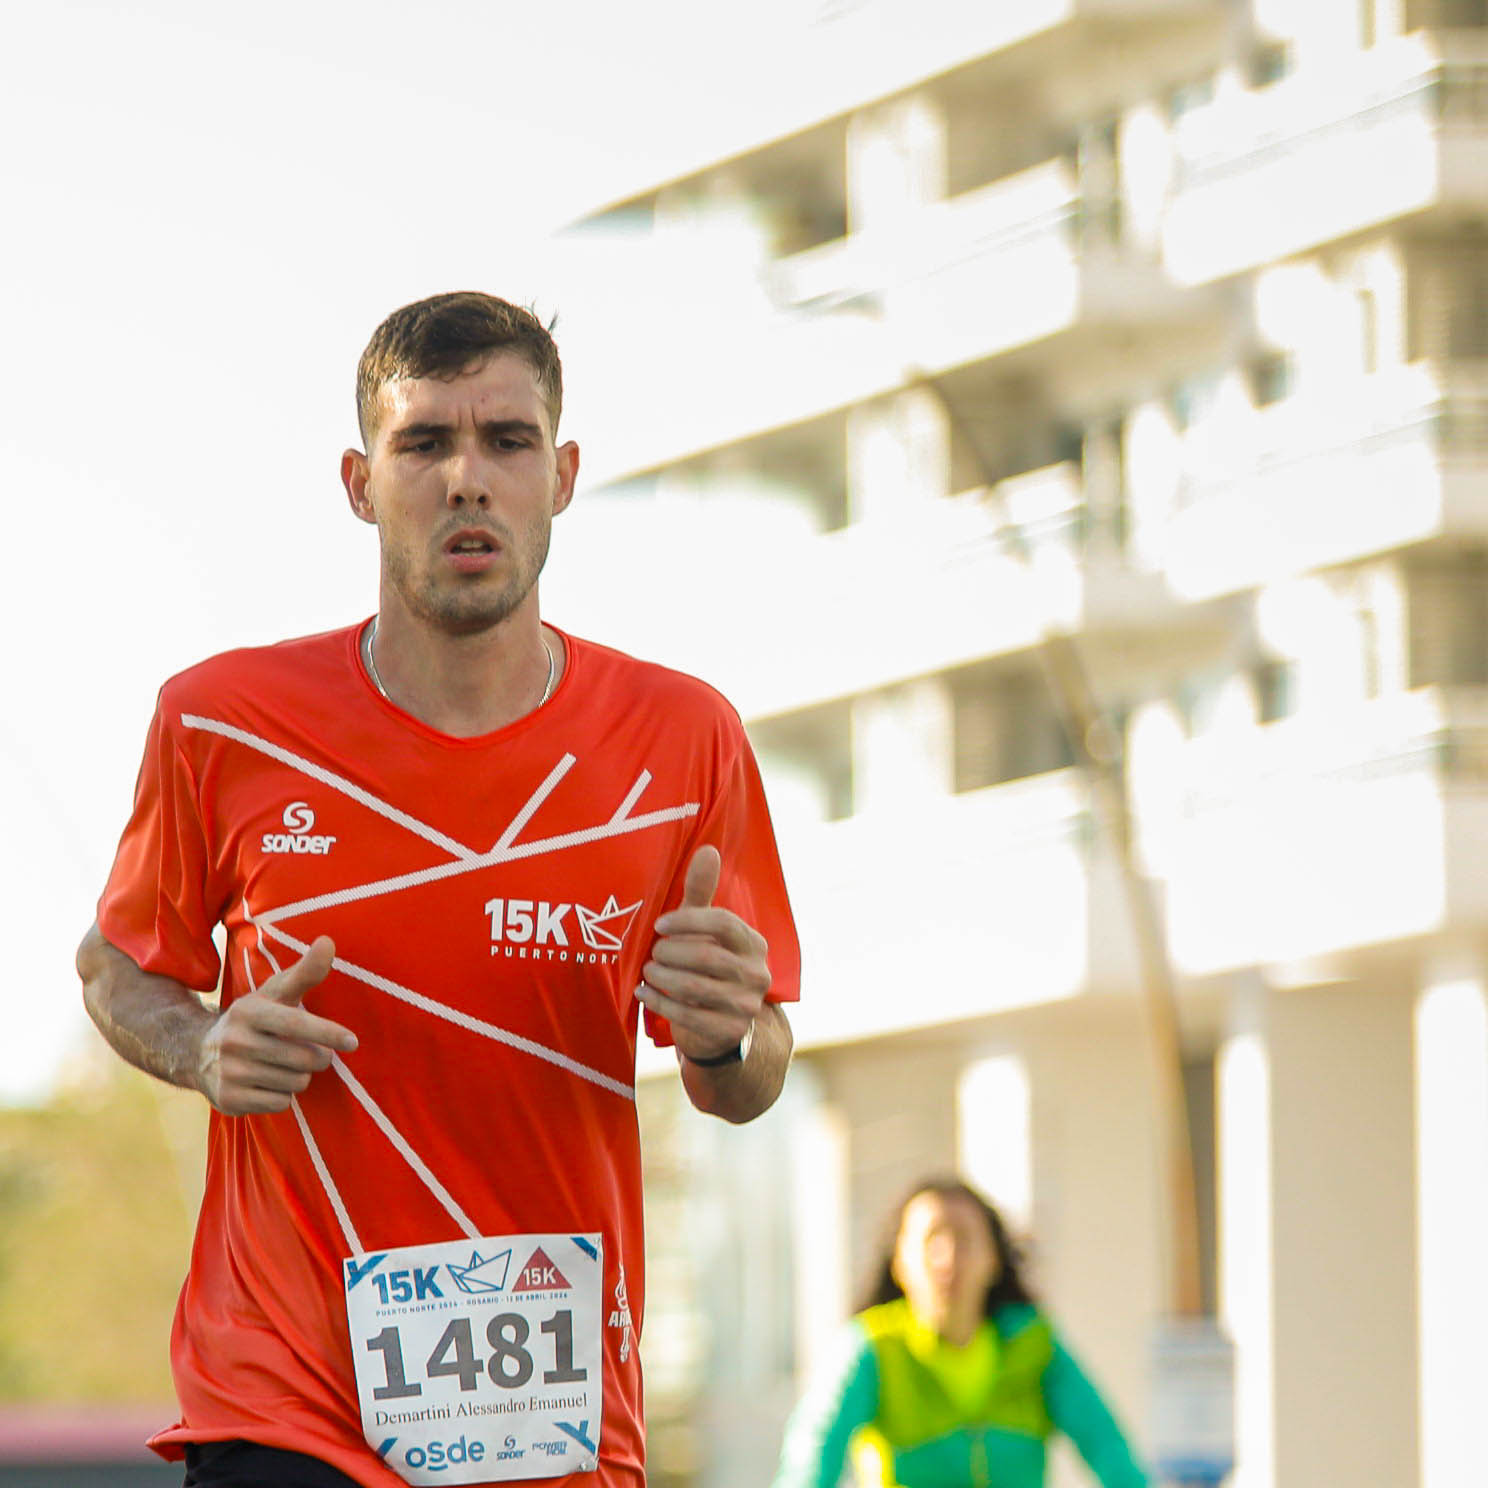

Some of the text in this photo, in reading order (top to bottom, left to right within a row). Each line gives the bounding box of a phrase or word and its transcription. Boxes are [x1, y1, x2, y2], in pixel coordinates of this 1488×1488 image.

[485, 898, 572, 946] 15K
[491, 945, 568, 961] PUERTO
[371, 1265, 444, 1305] 15K
[522, 1267, 557, 1287] 15K
[367, 1309, 588, 1400] 1481
[375, 1392, 587, 1427] Demartini Alessandro Emanuel
[405, 1435, 485, 1471] osde
